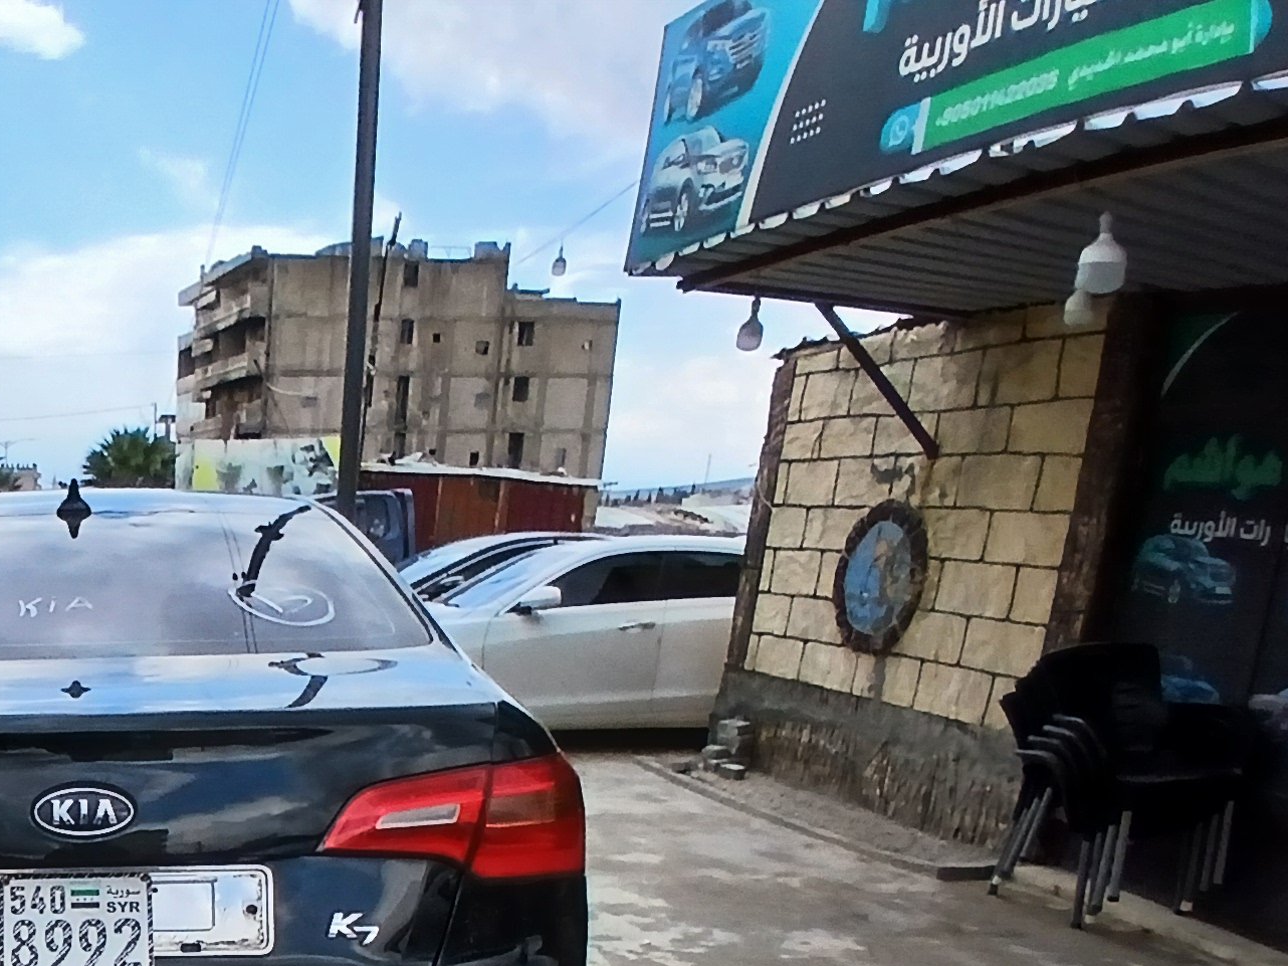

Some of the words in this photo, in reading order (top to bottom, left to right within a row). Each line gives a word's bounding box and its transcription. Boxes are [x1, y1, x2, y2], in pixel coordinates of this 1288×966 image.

[50, 798, 118, 826] KIA
[9, 885, 67, 915] 540
[106, 885, 141, 899] سورية
[106, 901, 141, 914] SYR
[327, 912, 380, 946] K7
